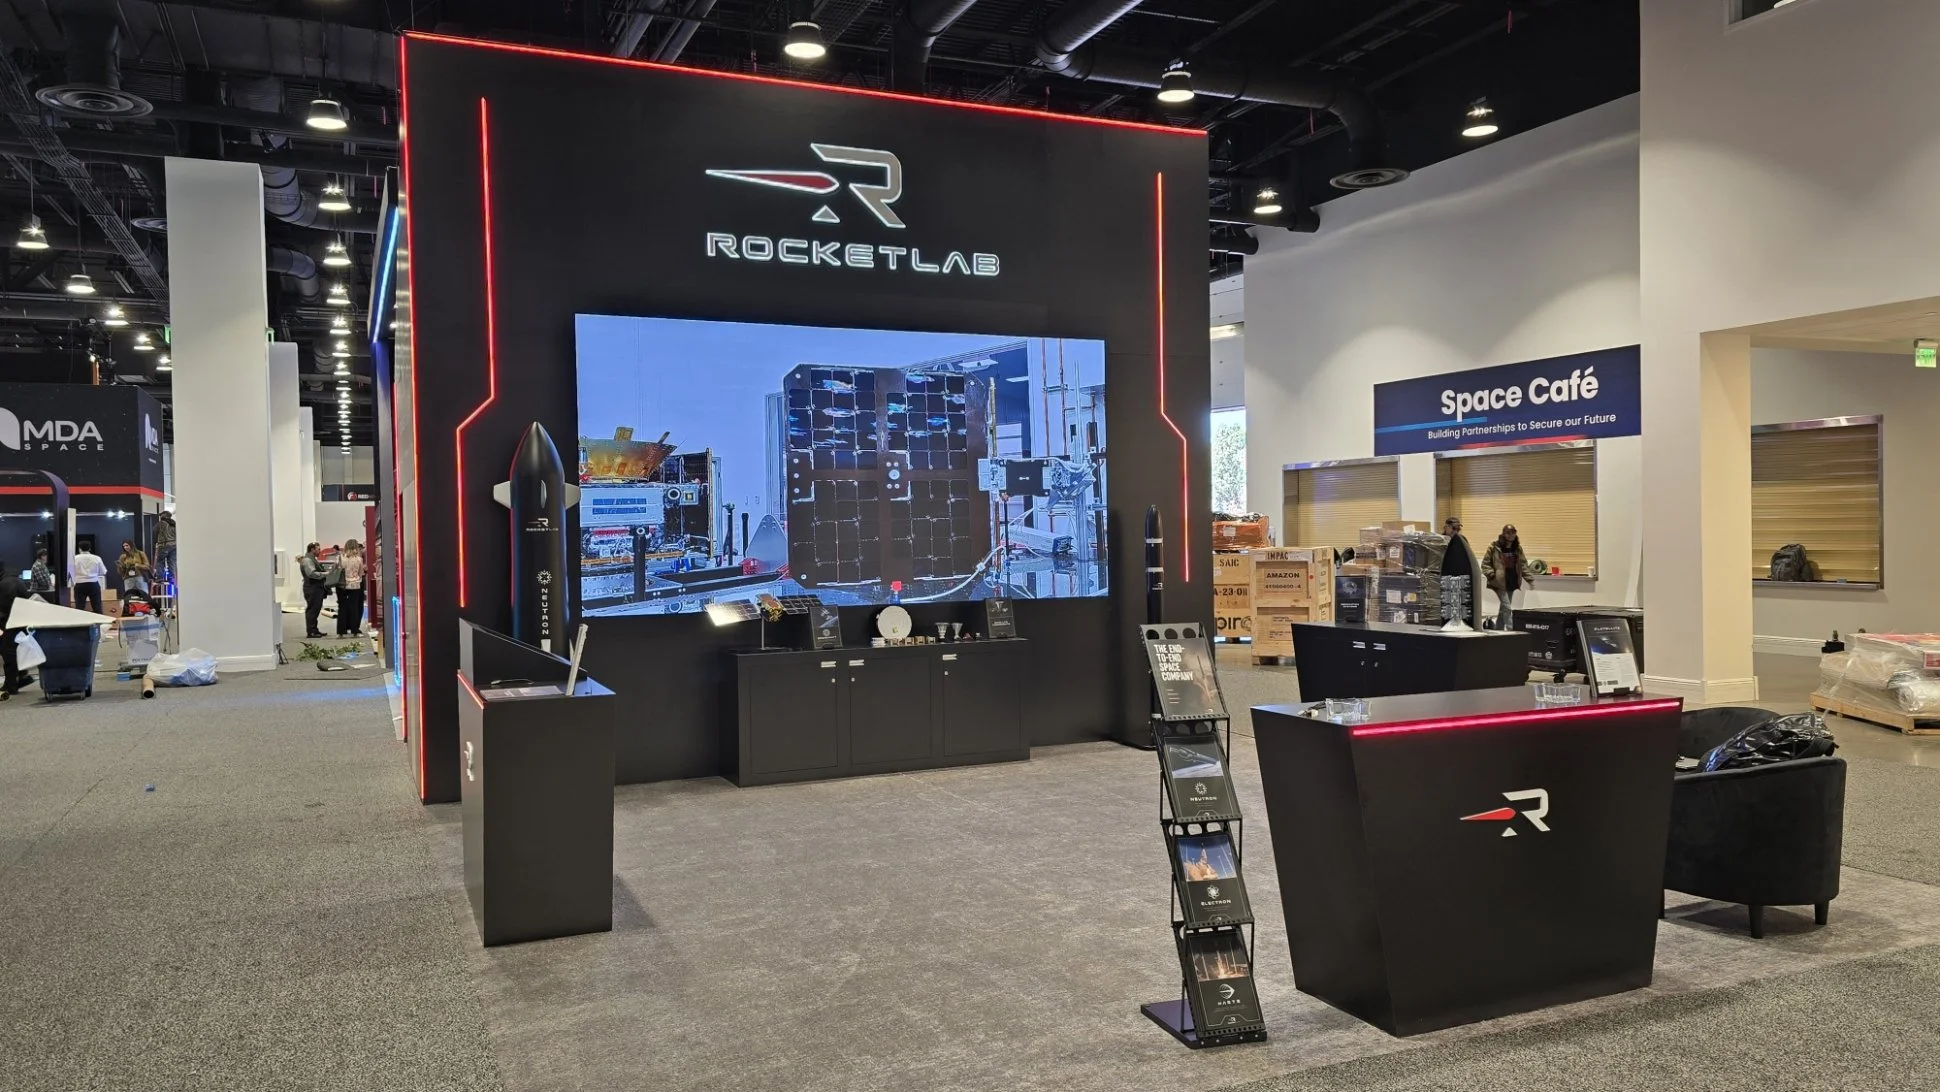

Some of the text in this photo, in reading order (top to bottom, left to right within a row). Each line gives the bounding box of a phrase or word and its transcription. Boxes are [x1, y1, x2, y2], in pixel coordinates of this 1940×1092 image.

[706, 232, 1000, 276] ROCKETLAB
[1440, 365, 1599, 422] Space Café
[23, 420, 104, 442] MDA
[1427, 413, 1617, 439] Building Partnerships to Secure our Future
[24, 443, 105, 451] SPACE
[1219, 558, 1240, 567] SAIC
[541, 588, 549, 635] NEUTRON
[1153, 644, 1185, 653] THE END-
[1156, 653, 1182, 662] TO-END
[1159, 662, 1181, 671] SPACE
[1161, 671, 1194, 681] COMPANY
